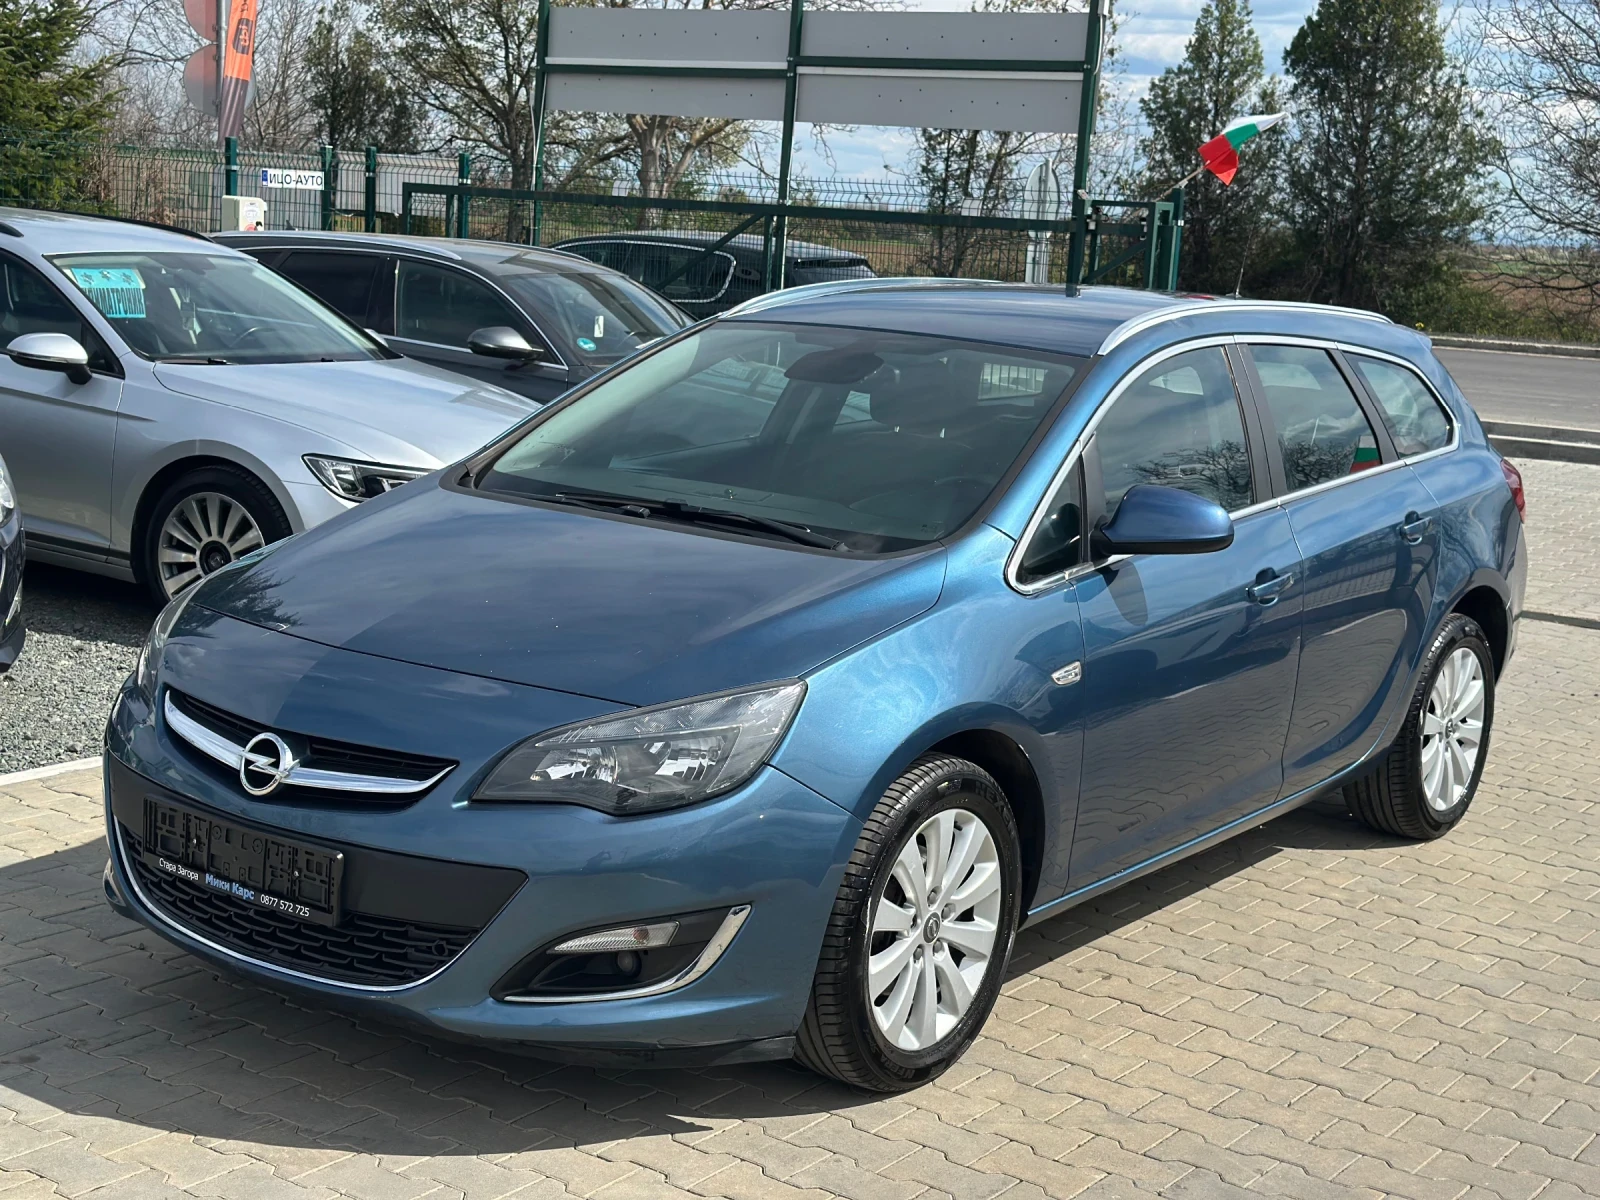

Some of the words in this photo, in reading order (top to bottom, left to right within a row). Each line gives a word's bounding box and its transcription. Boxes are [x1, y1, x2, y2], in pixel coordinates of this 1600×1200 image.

[269, 173, 323, 186] ИЦО-АУТО
[159, 857, 176, 872] Стара
[178, 864, 199, 881] Загора
[205, 873, 230, 891] Мики
[232, 882, 255, 900] Карс
[260, 894, 278, 907] 0877
[280, 900, 294, 912] 572
[295, 905, 310, 917] 725
